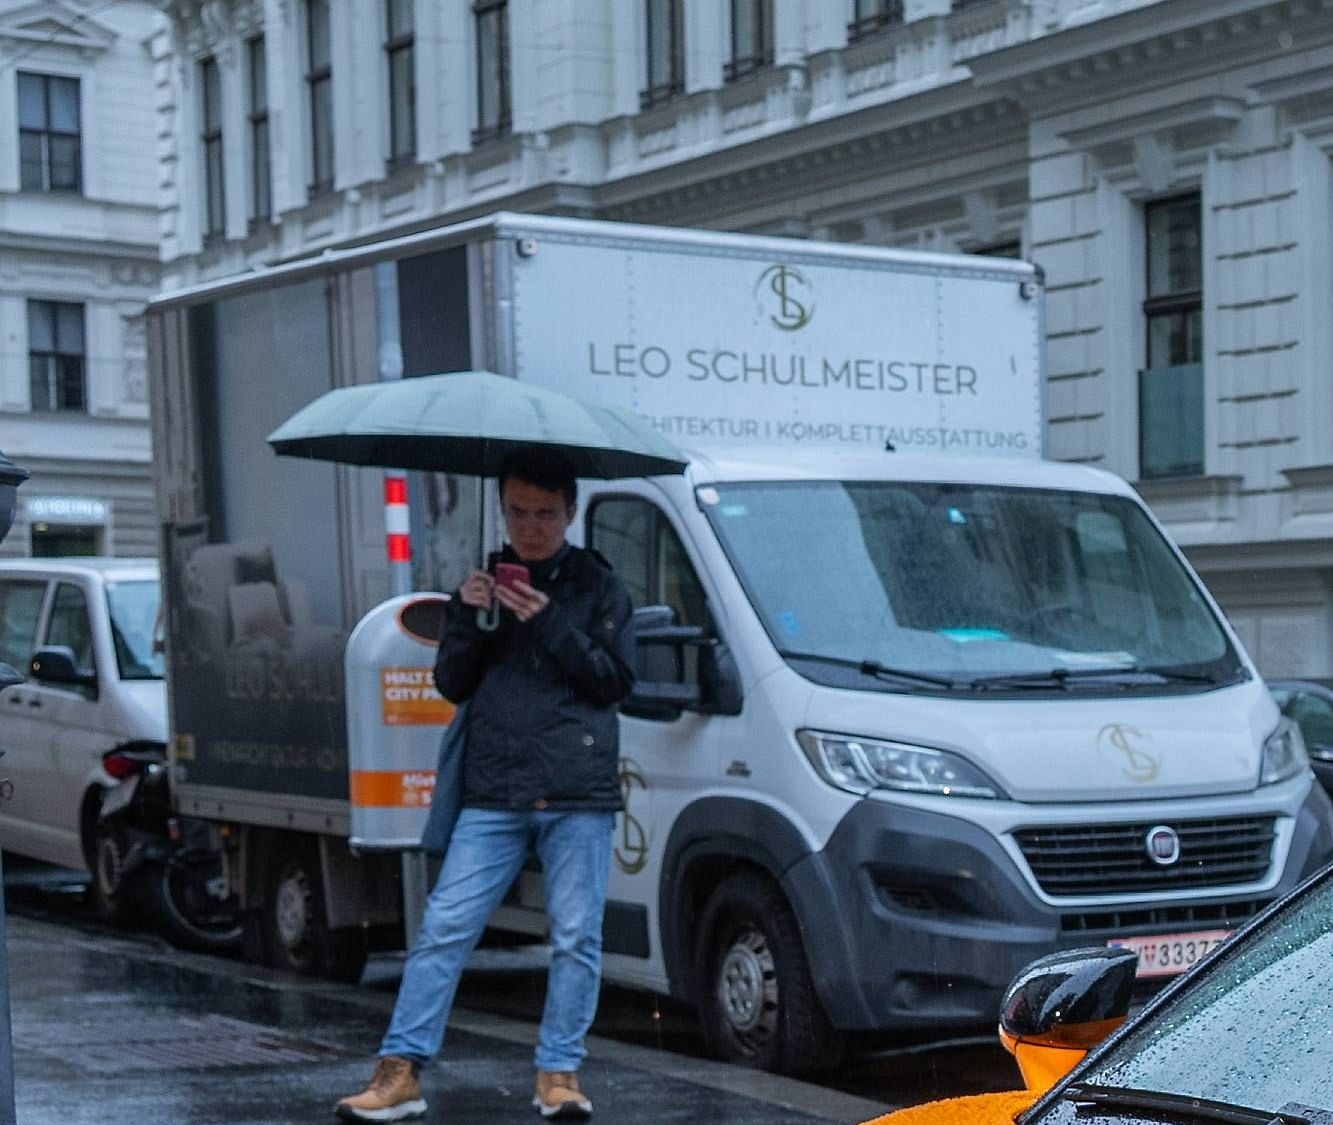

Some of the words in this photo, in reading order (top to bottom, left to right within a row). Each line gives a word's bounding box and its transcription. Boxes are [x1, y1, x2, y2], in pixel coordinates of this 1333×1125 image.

[589, 342, 670, 381] LEO
[686, 349, 978, 396] SCHULMEISTER
[777, 418, 1028, 450] KOMPLETTAUSSTATTUNG
[1160, 940, 1222, 966] 3337
